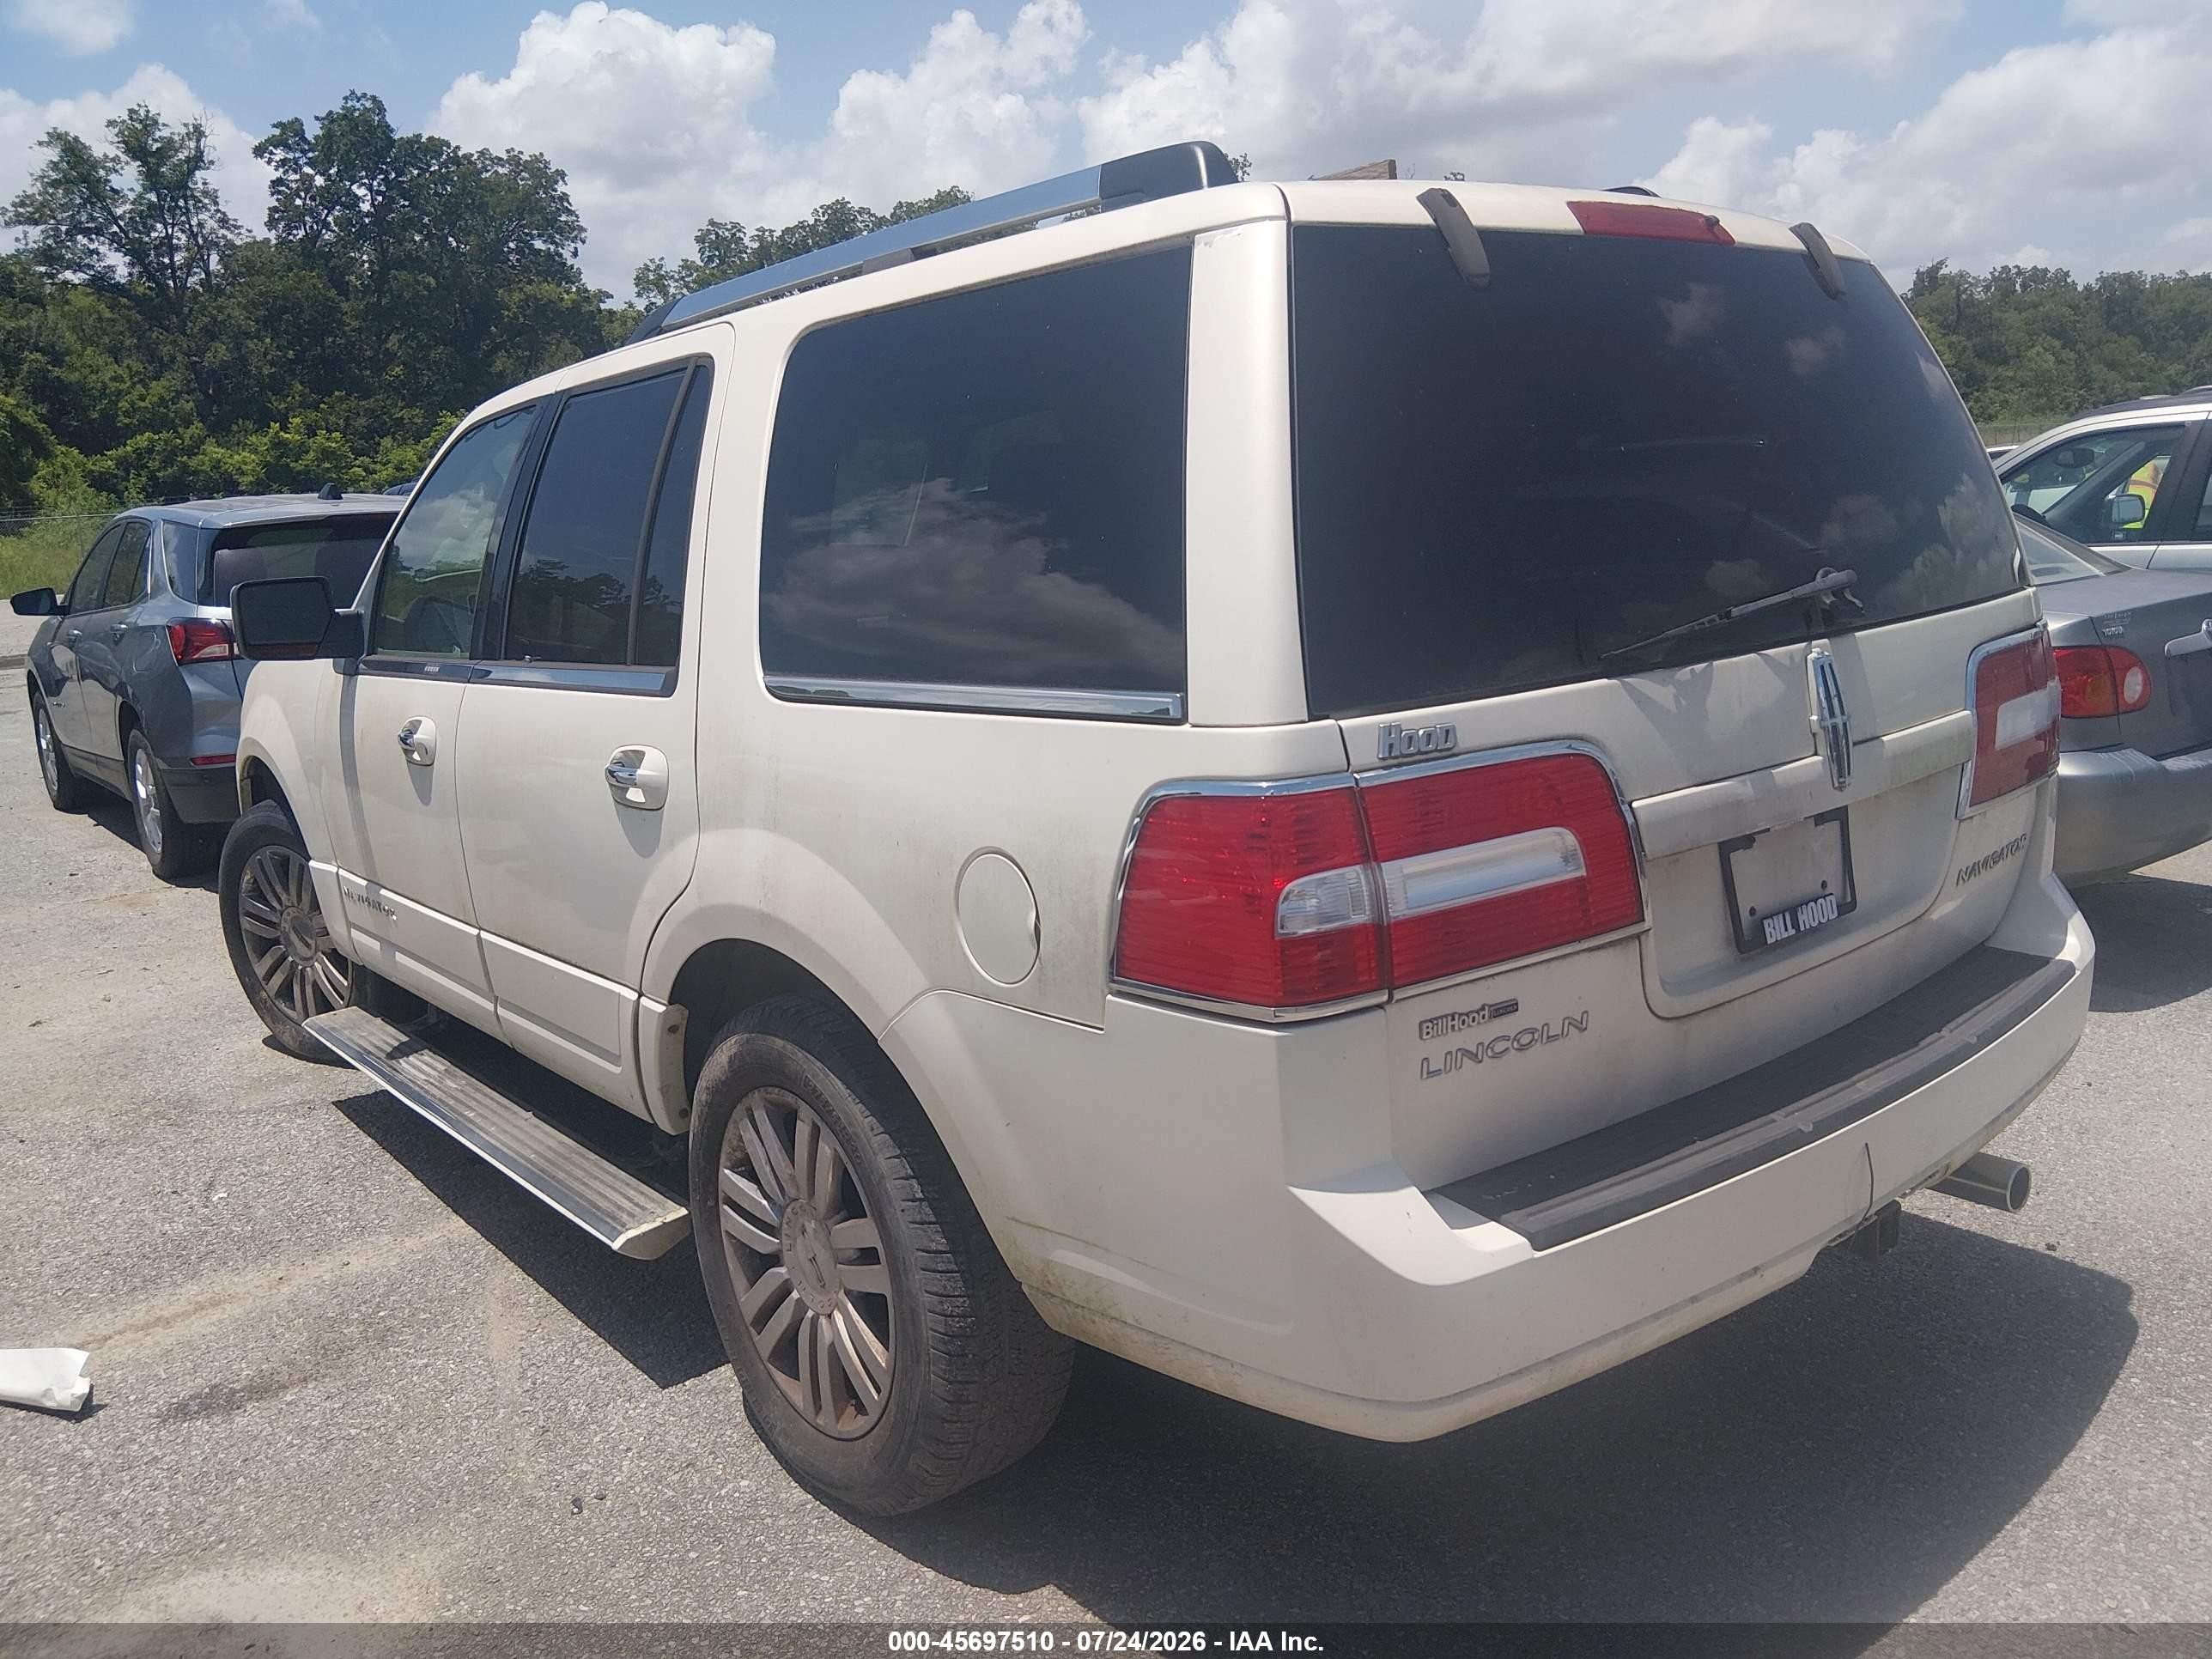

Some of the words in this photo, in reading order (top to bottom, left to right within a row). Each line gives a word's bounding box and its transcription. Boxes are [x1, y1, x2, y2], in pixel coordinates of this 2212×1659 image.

[1956, 832, 2027, 887] NAVIGATOR
[1763, 913, 1796, 945] BILL
[1797, 895, 1838, 932] HOOD
[1420, 1011, 1589, 1079] LINCOLN
